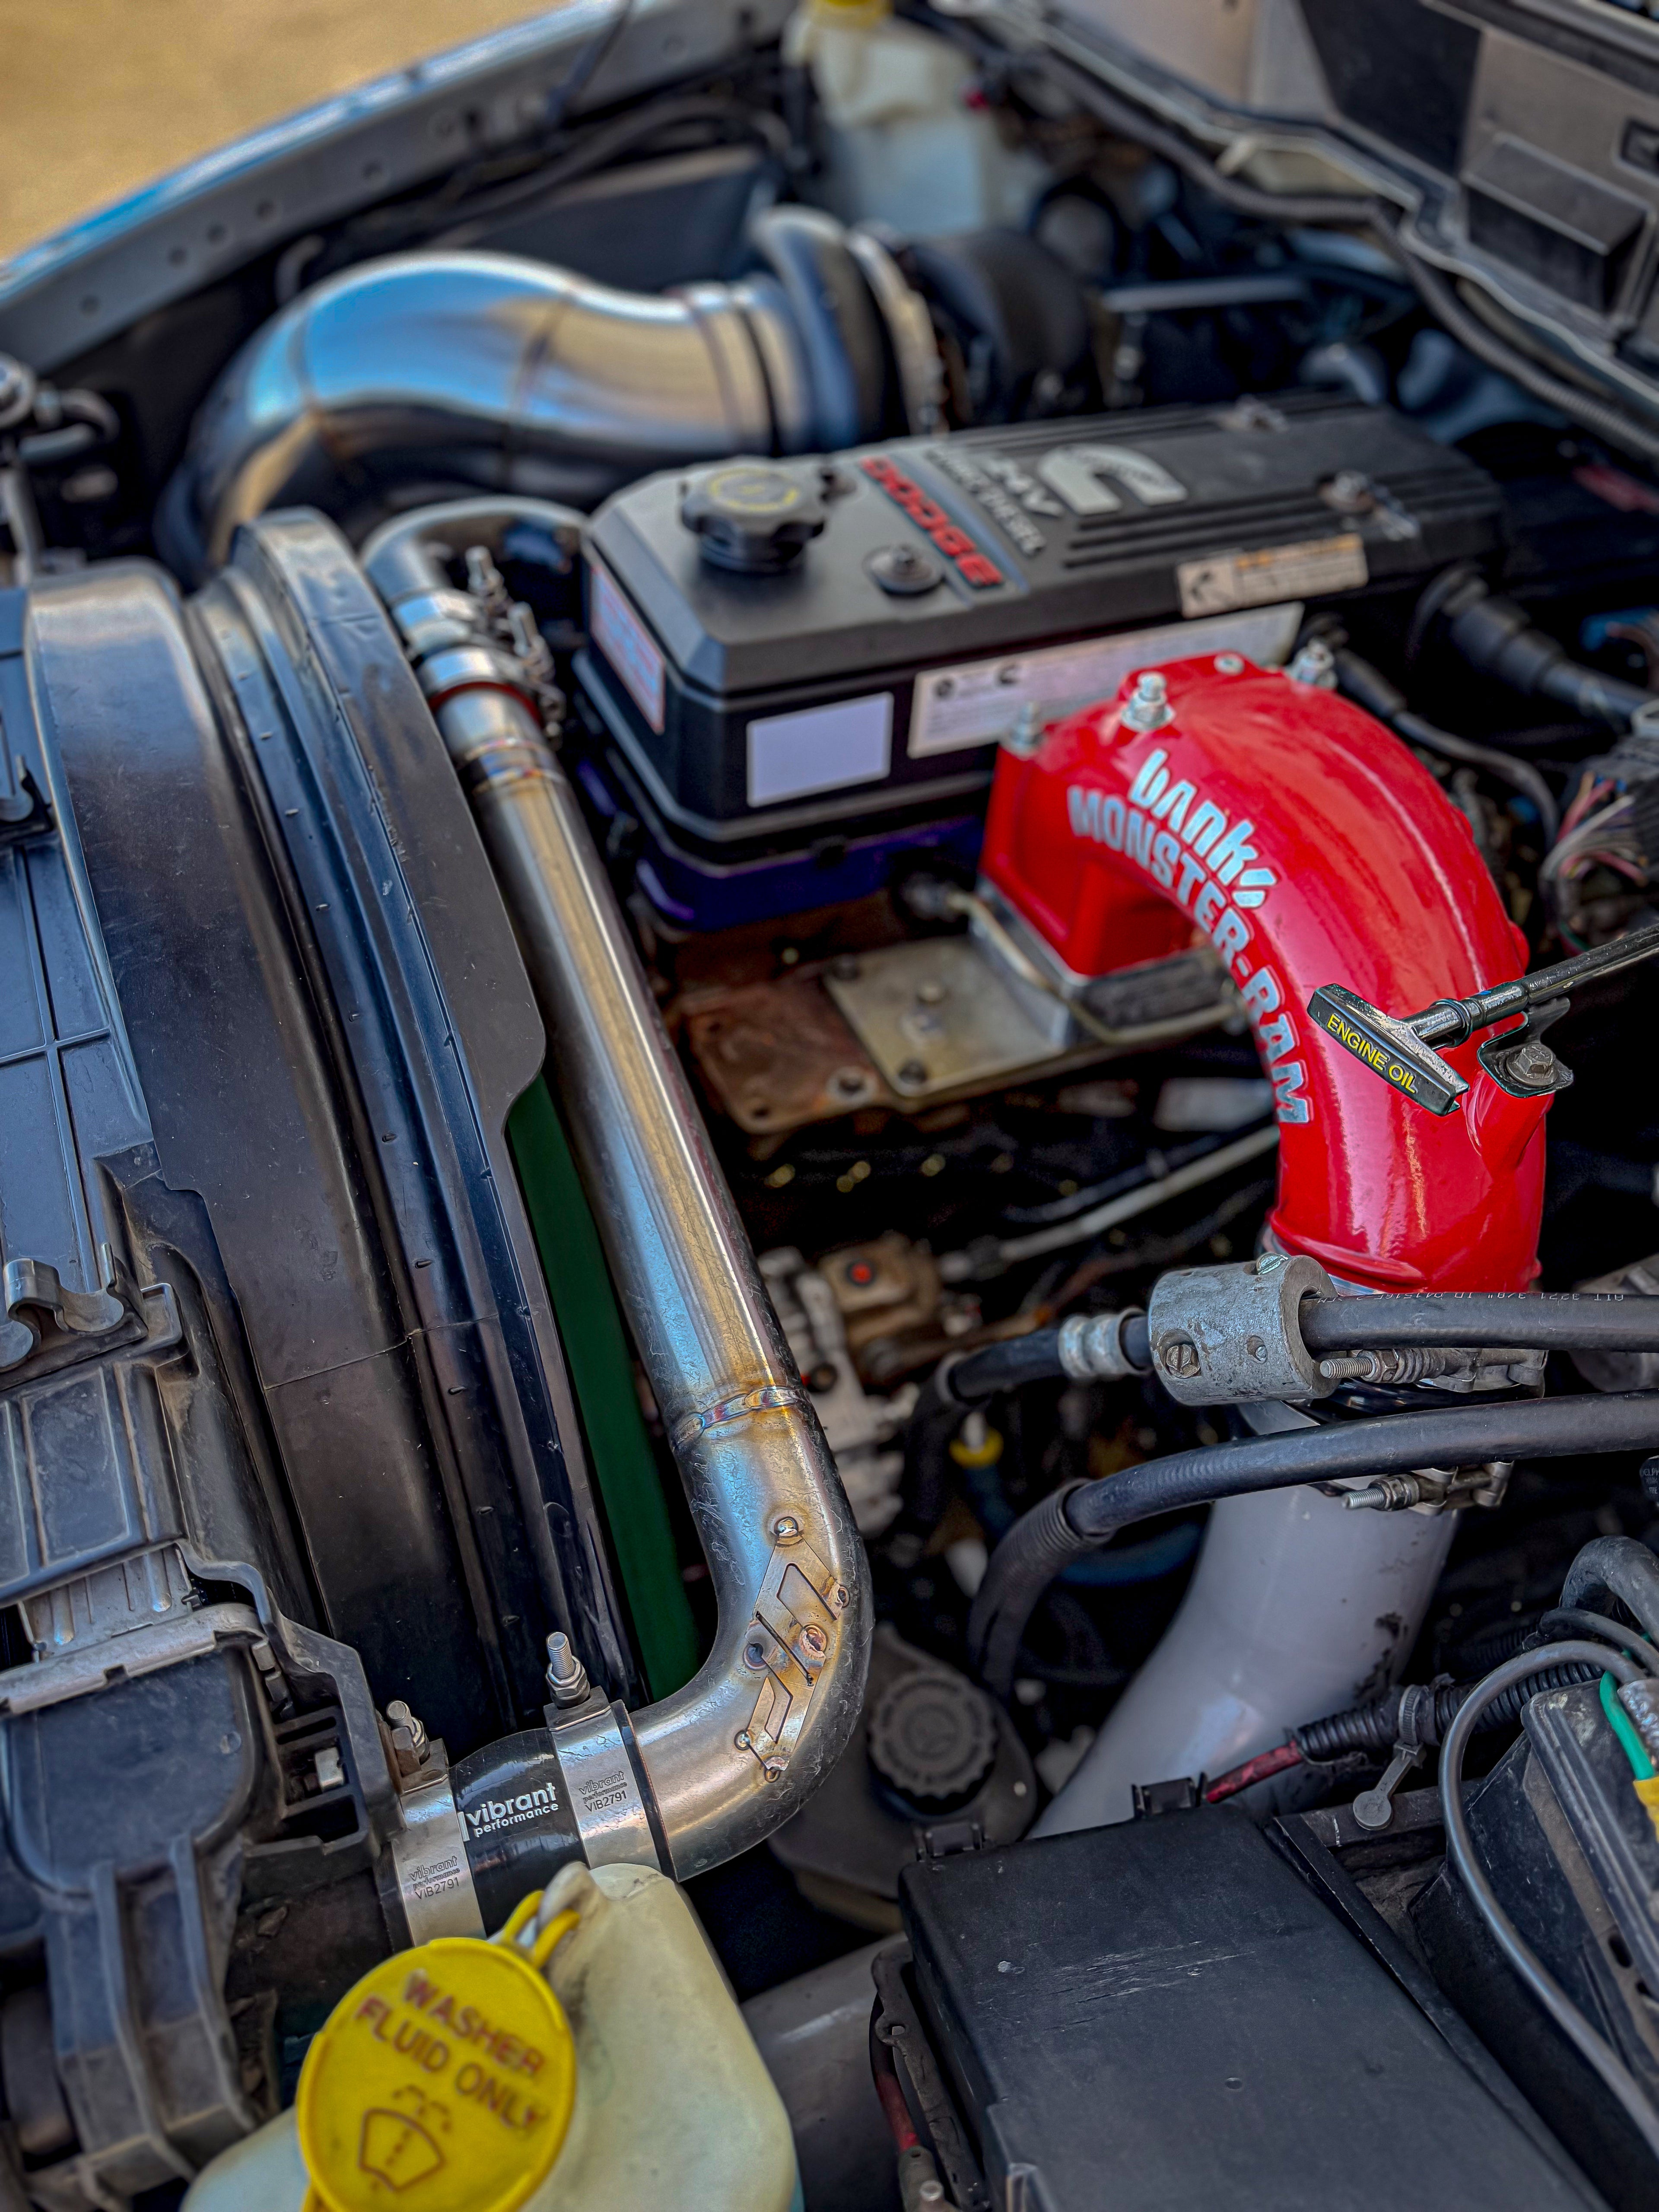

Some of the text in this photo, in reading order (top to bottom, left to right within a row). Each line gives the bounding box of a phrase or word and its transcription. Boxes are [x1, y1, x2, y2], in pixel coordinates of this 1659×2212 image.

[860, 455, 1003, 587] DODGE
[1067, 784, 1310, 1124] MONSTER-RAM
[1327, 1014, 1416, 1094] ENGINE OIL
[578, 1770, 625, 1795] vibrant
[583, 1782, 627, 1804] performance
[585, 1790, 627, 1812] VIB2791
[466, 1782, 557, 1826] vibrant
[474, 1803, 559, 1838] performance
[408, 1855, 458, 1881] vibrant
[415, 1876, 459, 1900] VIB2791
[402, 1968, 546, 2076] WASHER
[354, 1993, 548, 2131] FLUID ONLY
